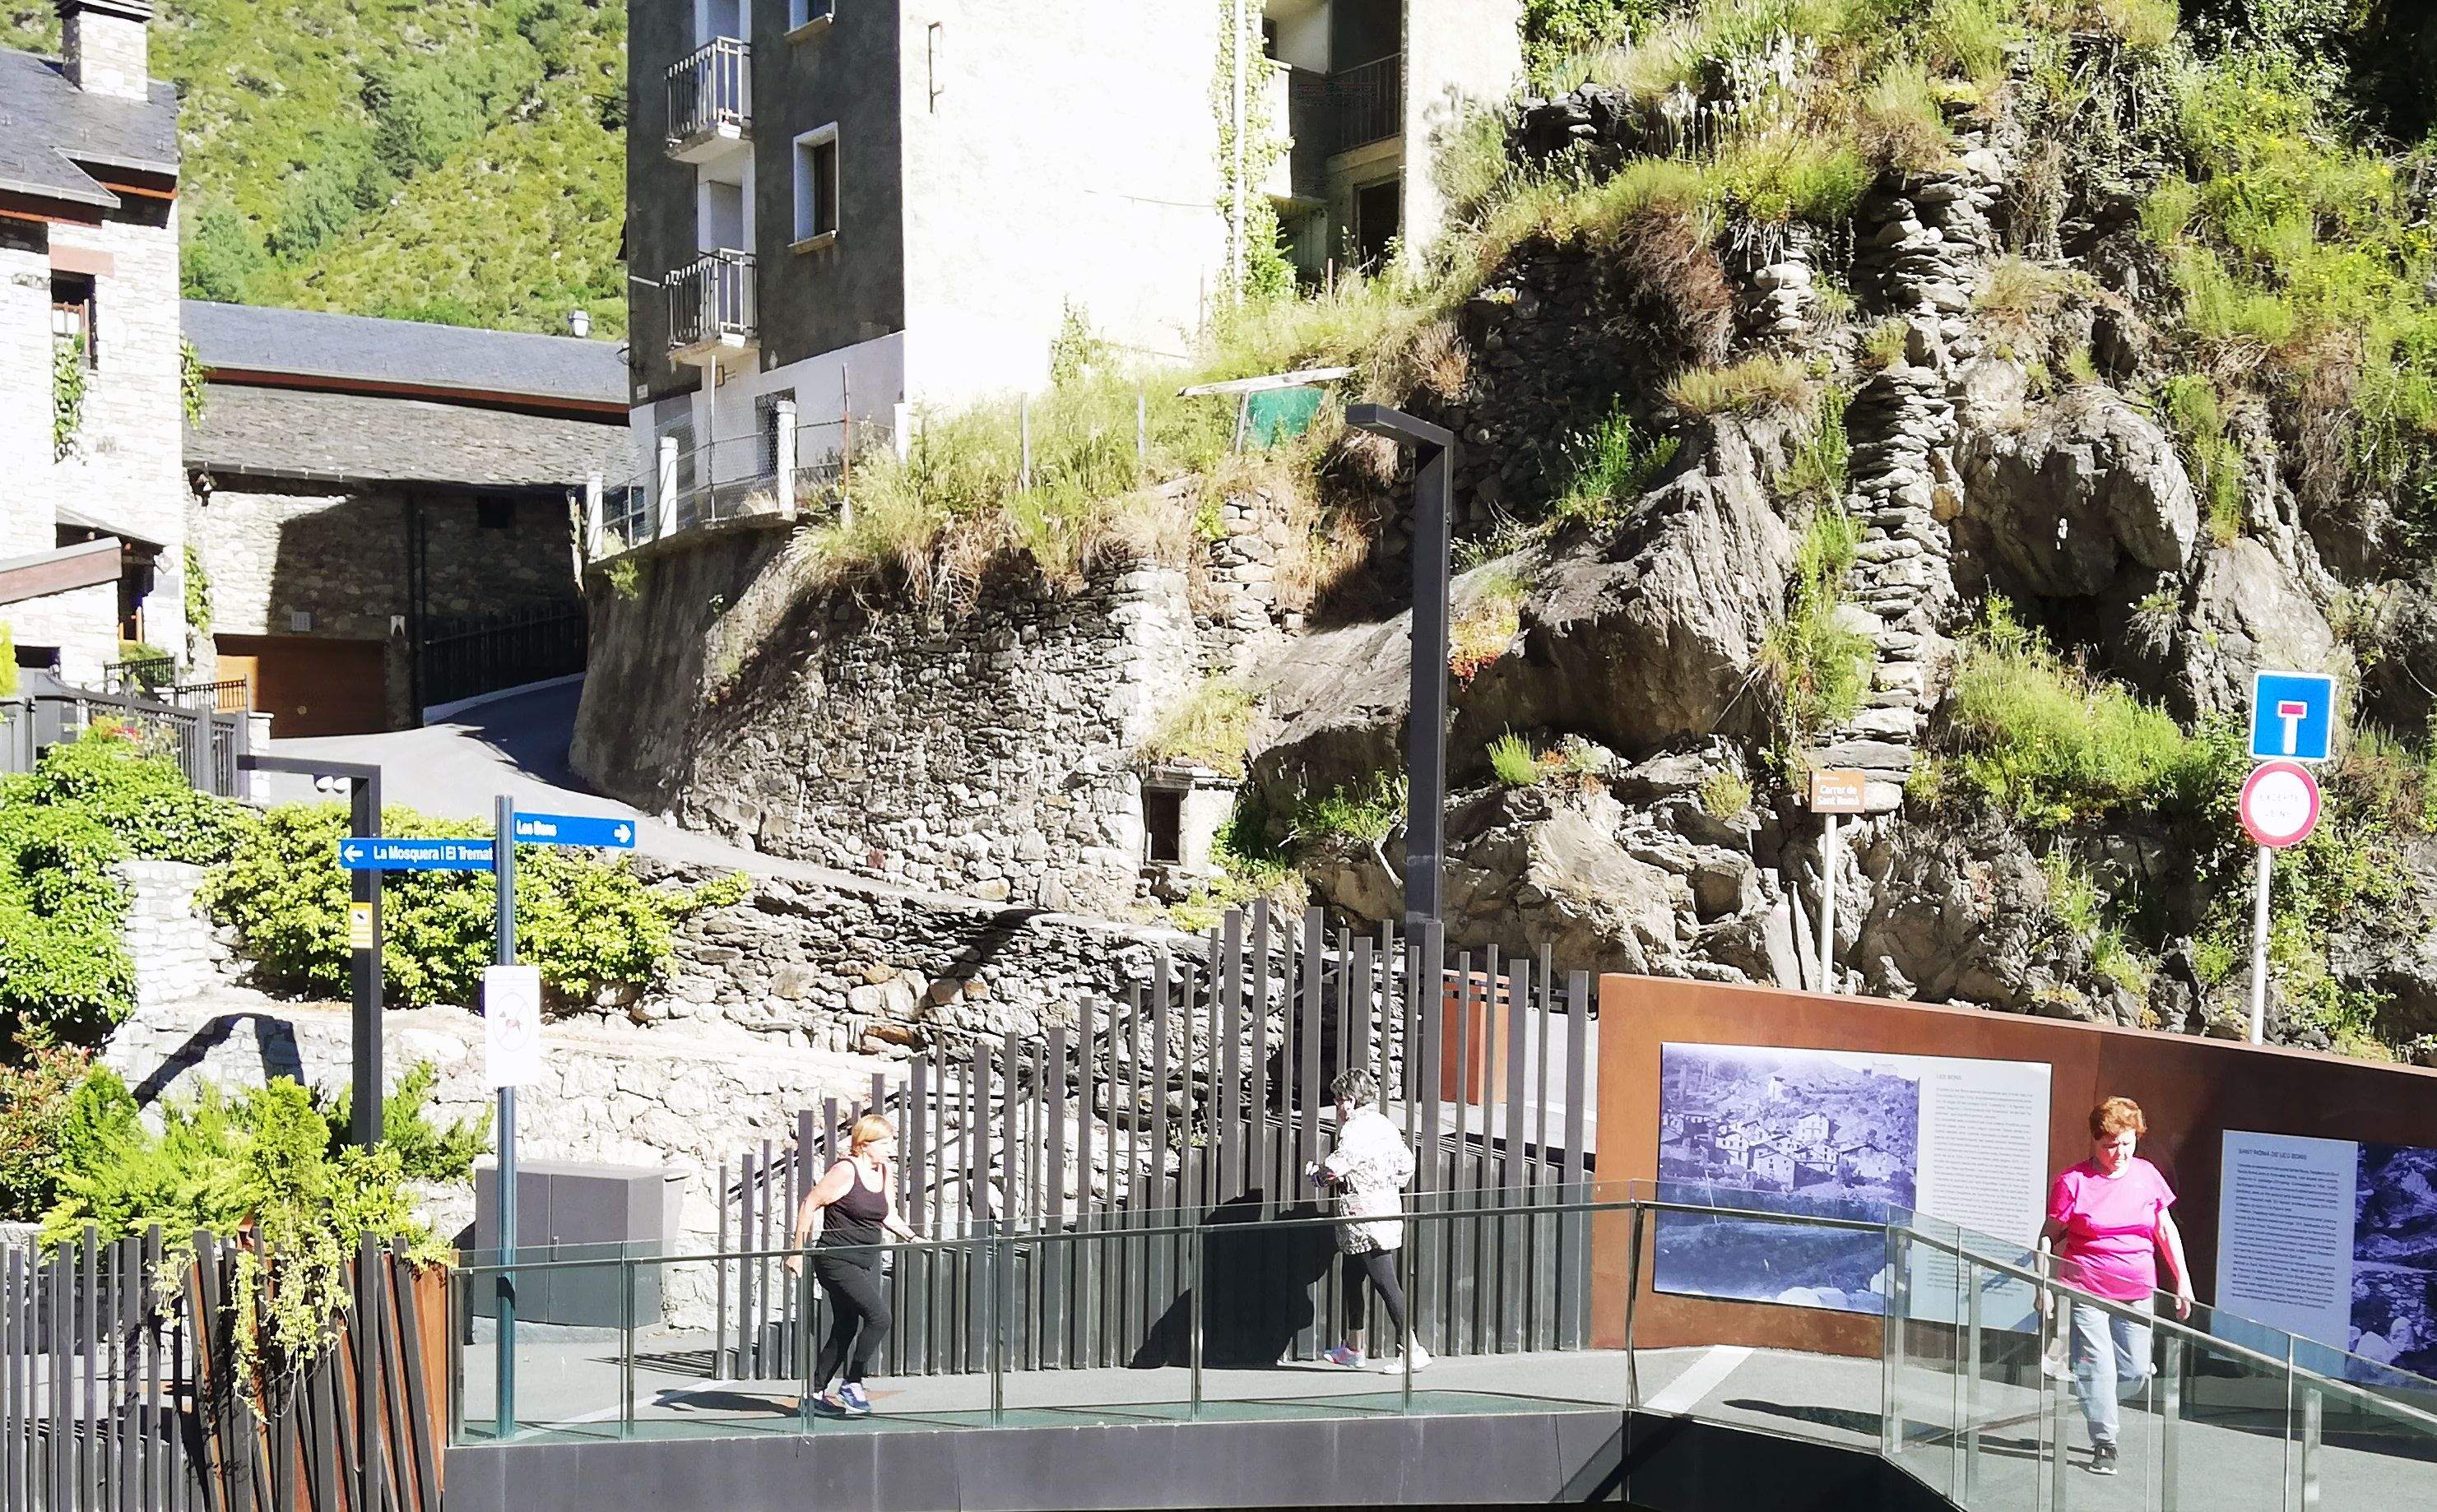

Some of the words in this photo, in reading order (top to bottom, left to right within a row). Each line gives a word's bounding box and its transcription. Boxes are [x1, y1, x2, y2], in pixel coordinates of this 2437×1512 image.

[373, 845, 388, 860] La
[388, 845, 440, 863] Mosquera
[445, 845, 457, 860] El
